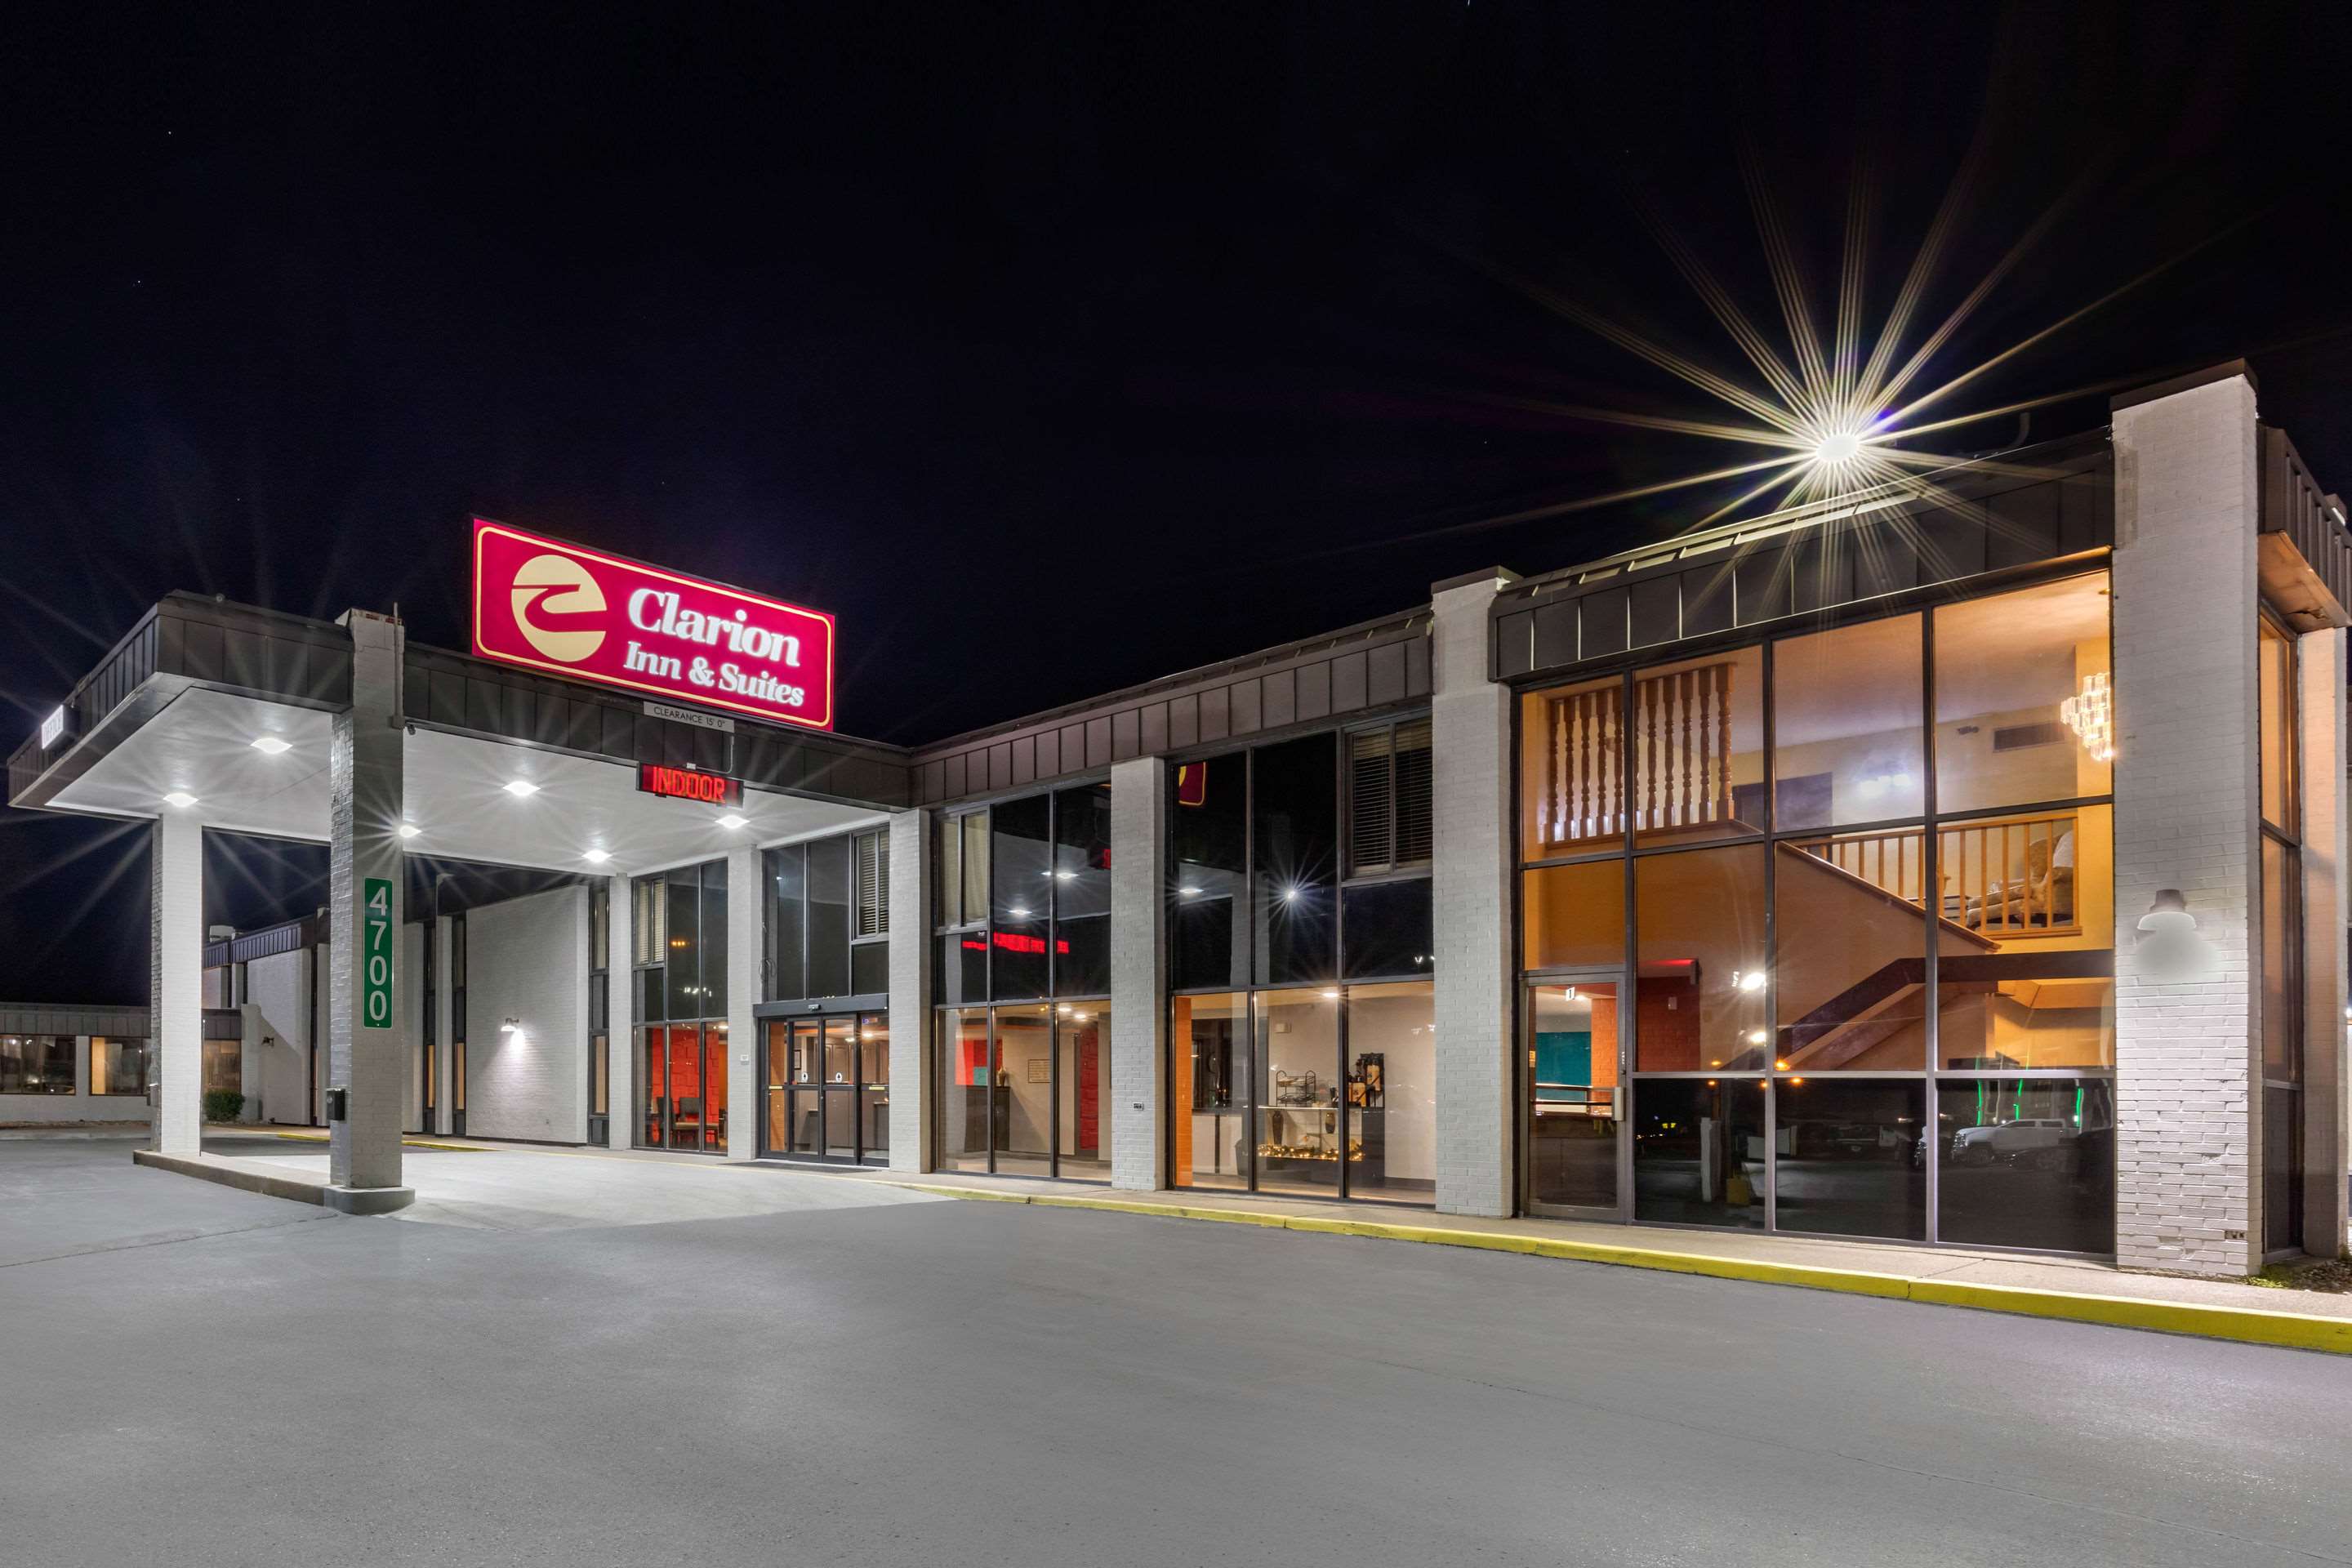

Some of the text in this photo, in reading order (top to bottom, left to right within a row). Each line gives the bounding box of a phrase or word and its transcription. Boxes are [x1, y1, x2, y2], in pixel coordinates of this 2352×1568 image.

[628, 588, 800, 666] Clarion
[623, 641, 804, 706] Inn & Suites
[653, 706, 702, 724] CLEARANCE
[653, 766, 725, 804] INDOOR
[369, 887, 388, 1021] 4700
